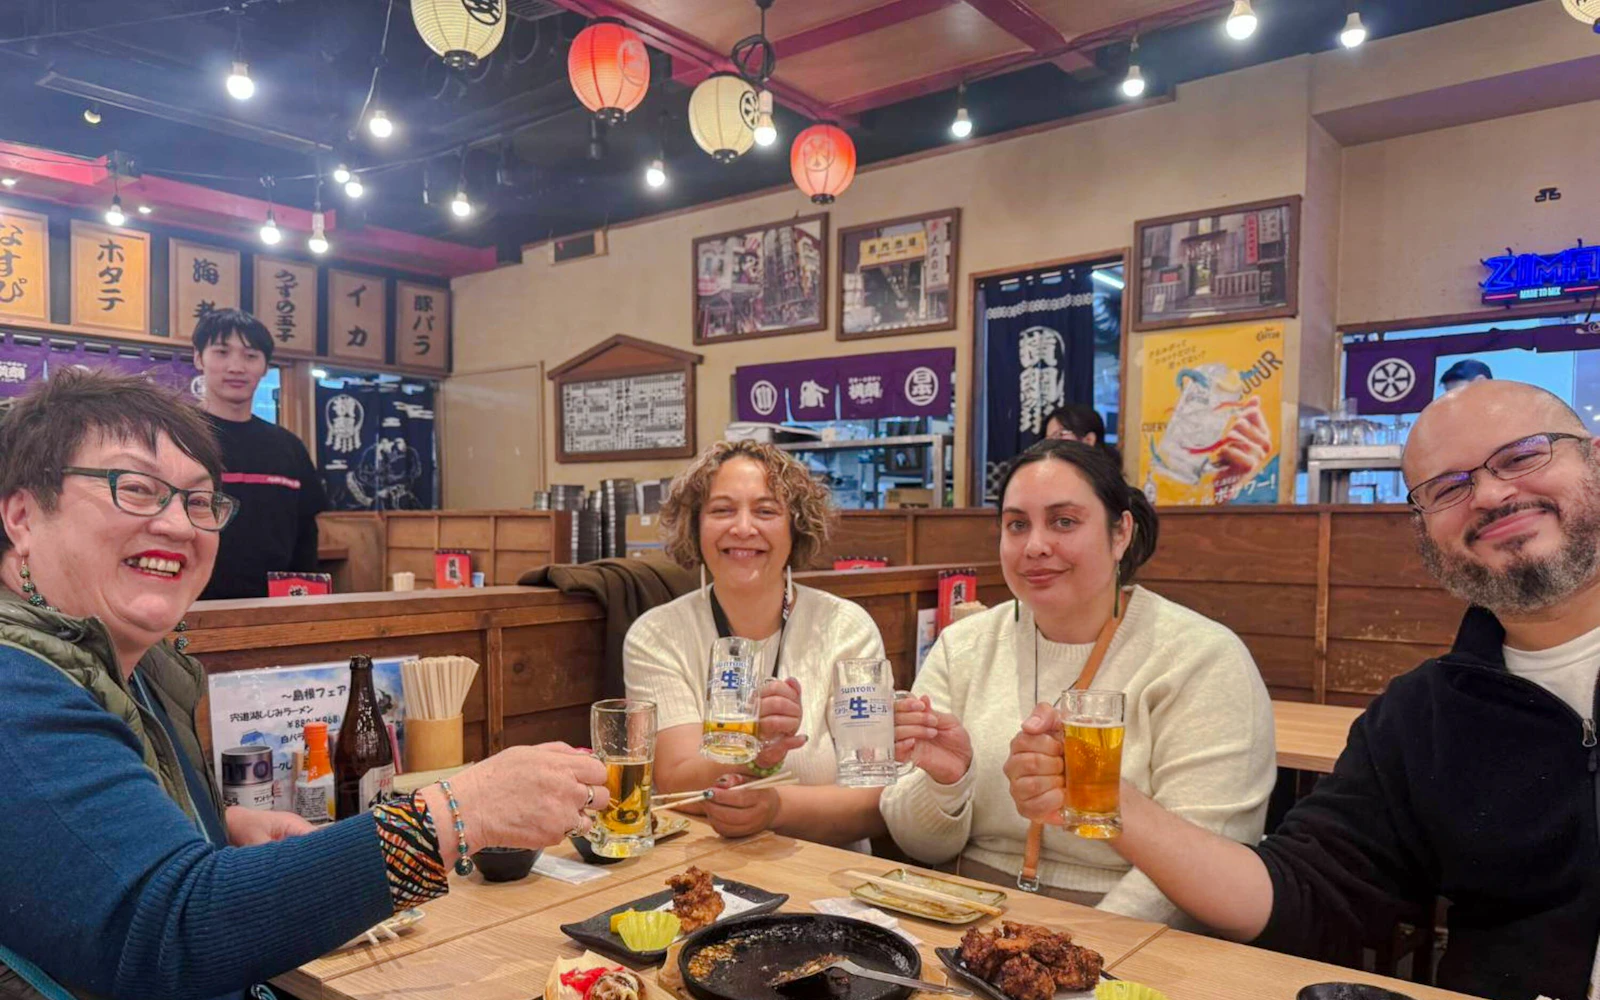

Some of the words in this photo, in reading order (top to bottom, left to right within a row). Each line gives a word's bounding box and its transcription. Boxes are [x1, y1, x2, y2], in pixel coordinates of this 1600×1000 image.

[97, 238, 125, 312] ホタテ
[346, 284, 368, 348] イカ
[412, 295, 435, 356] 豚バラ
[720, 669, 739, 690] 生
[849, 695, 870, 719] 生
